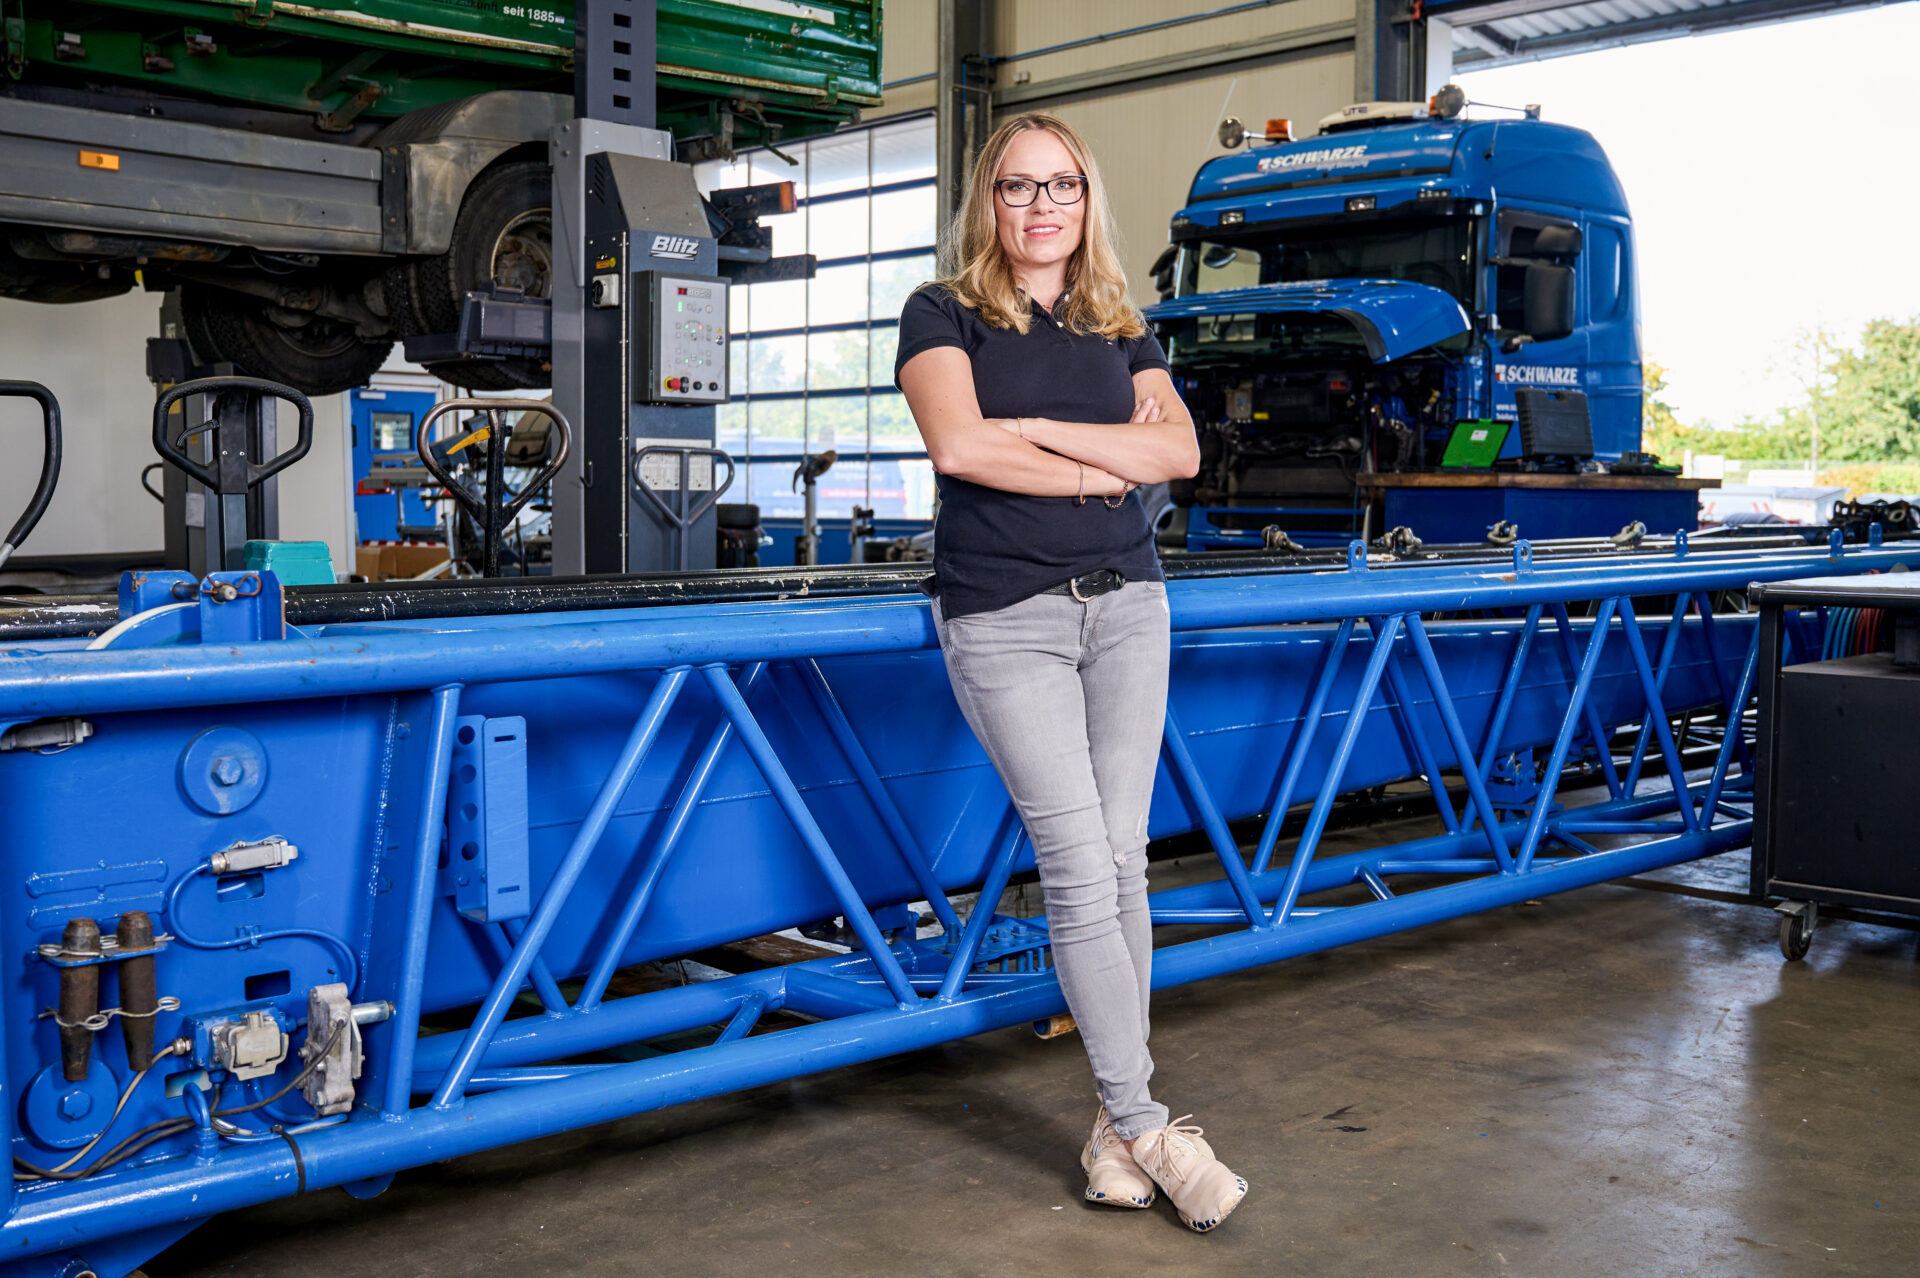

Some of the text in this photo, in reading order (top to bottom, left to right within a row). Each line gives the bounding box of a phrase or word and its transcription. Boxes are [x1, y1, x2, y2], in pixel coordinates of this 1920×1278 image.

[503, 5, 525, 17] seit
[527, 8, 555, 22] 1885
[1270, 145, 1368, 169] SCHWARZE
[651, 235, 699, 254] Blitz
[1507, 365, 1578, 384] SCHWARZE
